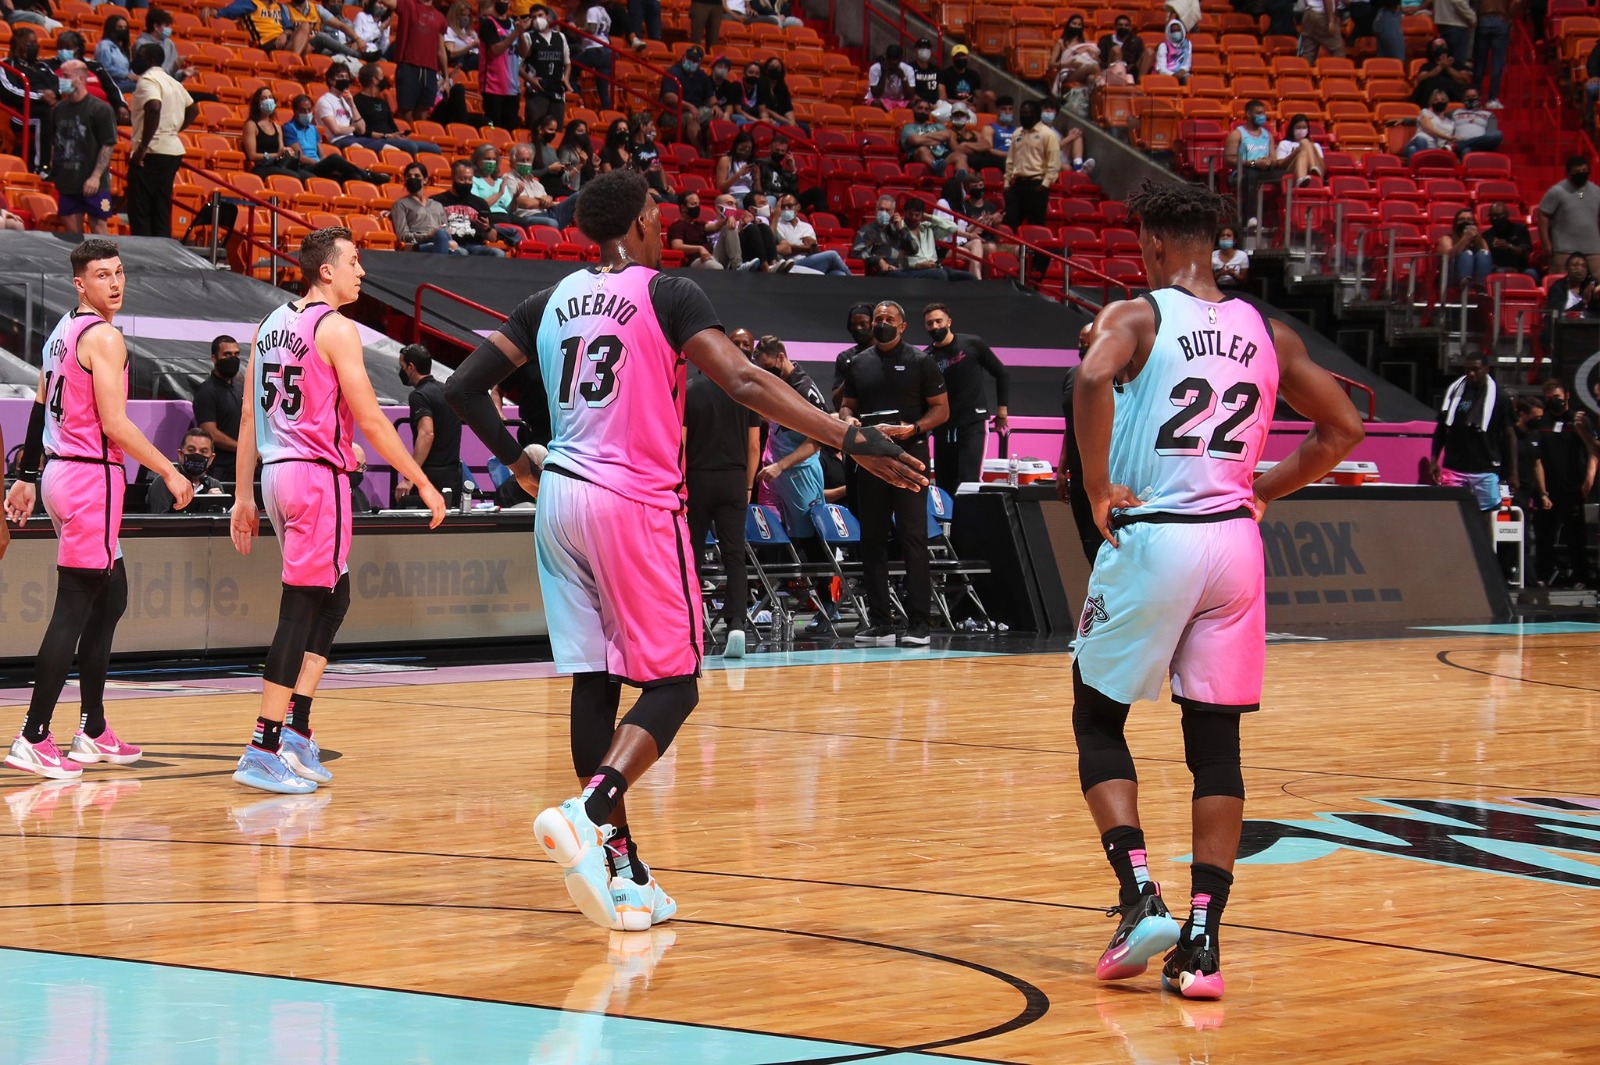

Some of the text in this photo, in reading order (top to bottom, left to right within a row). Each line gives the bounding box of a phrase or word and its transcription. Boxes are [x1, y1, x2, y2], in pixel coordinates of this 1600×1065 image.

[927, 81, 937, 90] 13
[555, 293, 638, 328] ADEBAYO
[256, 329, 310, 362] ROBINSON
[558, 334, 628, 411] 13
[1177, 330, 1258, 368] BUTLER
[45, 370, 66, 428] 14
[260, 362, 306, 421] 55
[1154, 376, 1262, 462] 22
[1260, 520, 1367, 578] max
[184, 561, 248, 618] be.
[357, 558, 509, 600] CARmax
